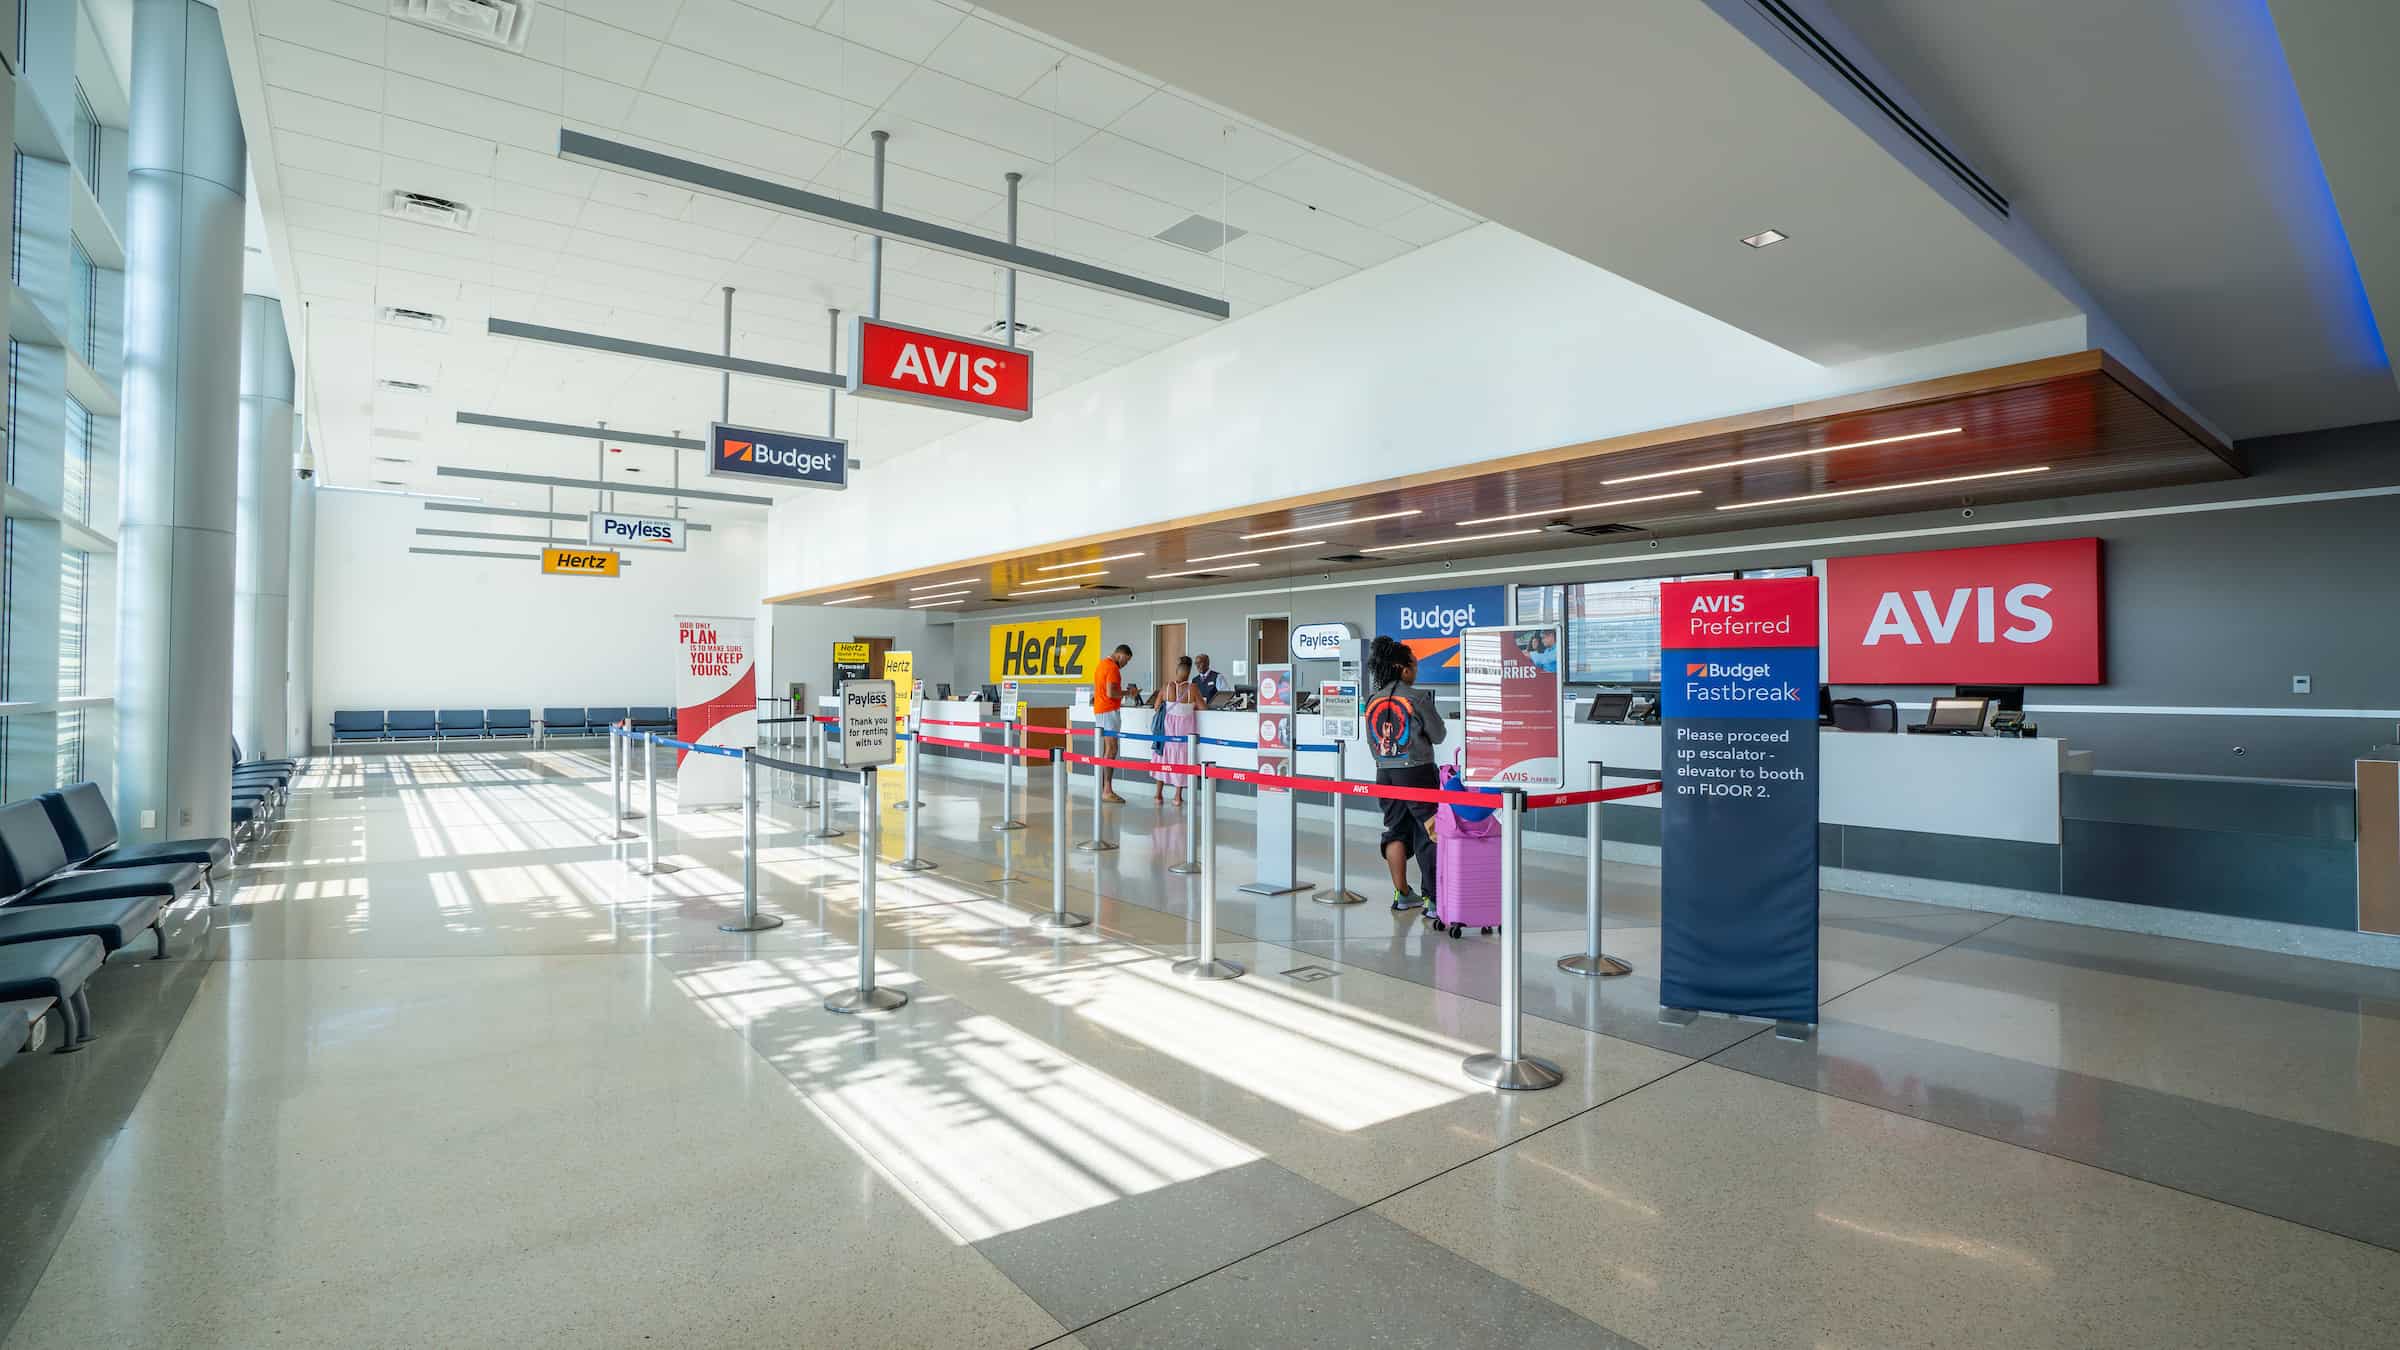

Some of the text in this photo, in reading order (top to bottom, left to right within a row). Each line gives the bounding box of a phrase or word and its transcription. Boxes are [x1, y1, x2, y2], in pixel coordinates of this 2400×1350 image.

[890, 343, 998, 396] AVIS
[755, 444, 832, 474] Budget
[604, 519, 671, 540] Payless
[557, 553, 607, 569] Hertz
[1690, 595, 1745, 614] AVIS
[1400, 603, 1476, 636] Budget
[1862, 583, 2054, 646] AVIS
[1690, 615, 1790, 636] Preferred
[680, 629, 717, 645] PLAN
[1300, 632, 1340, 651] Payless
[840, 643, 864, 652] Hertz
[1003, 627, 1087, 676] Hertz
[690, 651, 744, 665] YOU KEEP
[886, 659, 911, 673] Hertz
[690, 664, 732, 677] YOURS.
[1709, 663, 1771, 682] Budget
[1686, 681, 1796, 701] Fastbreak
[848, 691, 888, 708] Payless
[850, 717, 873, 726] Thank
[875, 717, 888, 727] you
[849, 727, 888, 737] for renting
[1677, 728, 1790, 745] Please proceed
[856, 739, 883, 747] with us
[1677, 749, 1696, 762] up
[1699, 747, 1767, 761] escalator
[1502, 771, 1529, 782] AVIS
[1677, 765, 1805, 781] elevator to booth
[1353, 785, 1369, 794] AVIS
[1677, 783, 1771, 798] on FLOOR 2.
